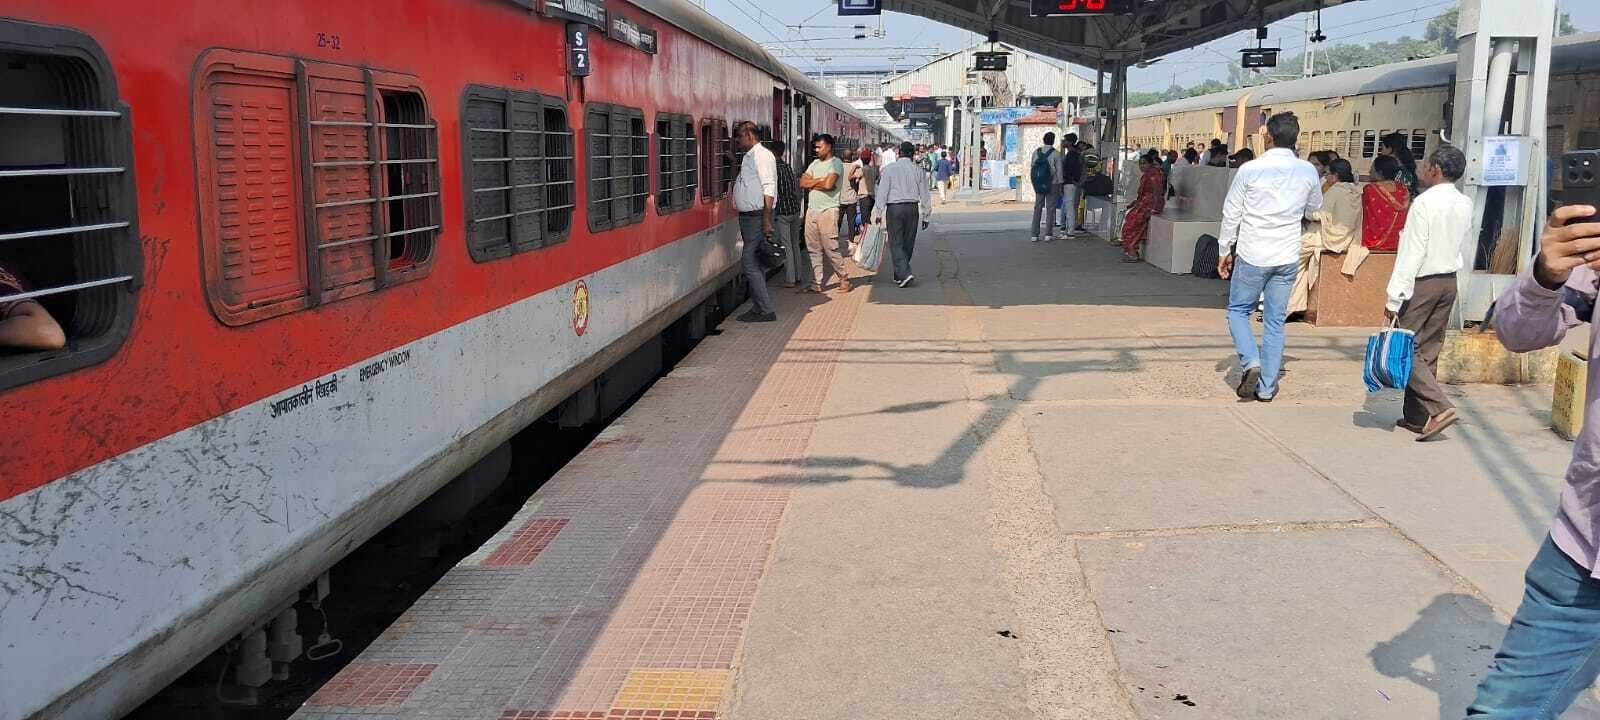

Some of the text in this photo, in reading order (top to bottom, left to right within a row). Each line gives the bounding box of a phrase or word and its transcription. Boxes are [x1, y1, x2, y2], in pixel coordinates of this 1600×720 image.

[317, 32, 341, 50] 25-32
[575, 31, 583, 47] S
[577, 53, 585, 68] 2
[359, 350, 410, 382] EMERGENCY WINDOW
